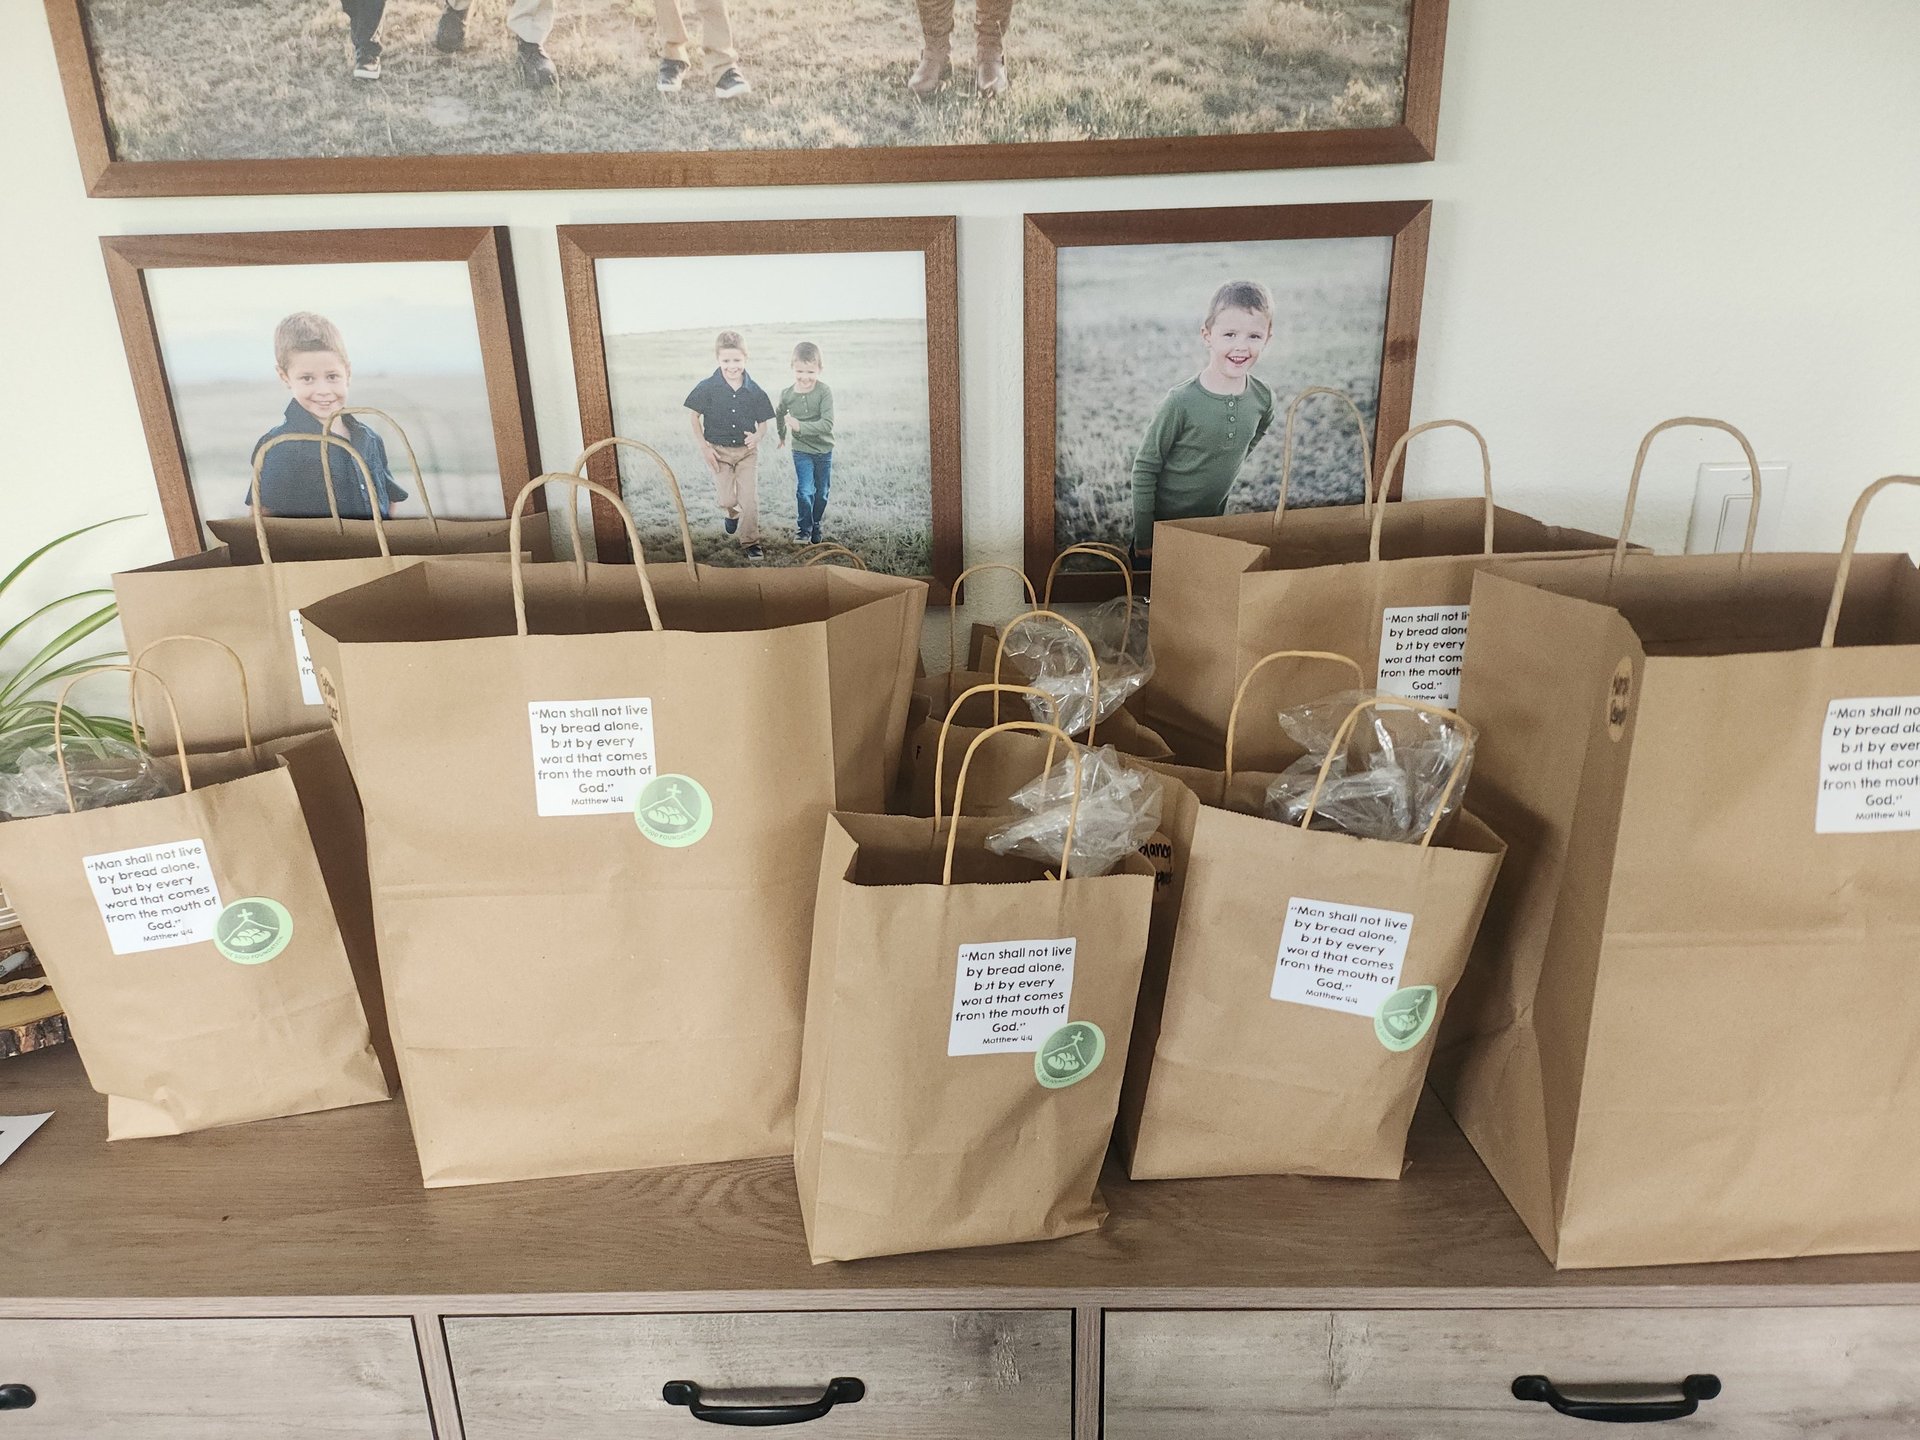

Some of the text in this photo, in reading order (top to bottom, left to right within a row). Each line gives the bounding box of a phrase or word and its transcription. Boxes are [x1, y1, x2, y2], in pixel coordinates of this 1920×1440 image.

[1386, 615, 1413, 623] “Man
[1417, 613, 1439, 622] shall
[1390, 628, 1403, 638] by
[1407, 627, 1438, 636] bread
[1416, 642, 1429, 651] by
[1433, 641, 1464, 649] every
[1415, 654, 1435, 663] that
[1409, 668, 1425, 676] the
[1412, 681, 1442, 690] God.”
[532, 706, 648, 718] “Man shall not live
[1830, 708, 1865, 719] “Man
[1870, 705, 1901, 717] shall
[540, 722, 643, 735] by bread alone,
[1833, 726, 1851, 738] by
[1855, 723, 1899, 735] bread
[576, 739, 592, 749] by
[597, 737, 634, 747] every
[1868, 742, 1885, 754] by
[577, 753, 601, 762] that
[607, 751, 647, 761] comes
[1867, 758, 1893, 770] that
[573, 769, 592, 778] the
[597, 766, 635, 777] mouth
[640, 765, 652, 774] of
[579, 784, 613, 793] God.”
[1861, 777, 1881, 788] the
[572, 797, 609, 805] Matthew
[1866, 794, 1902, 806] God.”
[1856, 812, 1895, 820] Matthew
[88, 847, 201, 871] “Man shall not live
[98, 861, 199, 884] by bread alone,
[112, 876, 193, 895] but by every
[106, 886, 210, 909] word that comes
[106, 897, 216, 923] from the mouth of
[1291, 906, 1407, 930] “Man shall not live
[147, 919, 181, 930] God.”
[1294, 919, 1397, 943] by bread alone,
[144, 934, 178, 942] Matthew
[1326, 937, 1342, 949] by
[1347, 942, 1385, 955] every
[962, 946, 1072, 961] “Man shall not live
[1324, 951, 1348, 961] that
[1352, 957, 1394, 970] comes
[967, 963, 1064, 978] by bread alone,
[1314, 963, 1334, 974] the
[1338, 969, 1377, 982] mouth
[1381, 975, 1395, 985] of
[998, 981, 1014, 990] by
[1019, 979, 1055, 988] every
[1317, 978, 1351, 991] God.”
[997, 994, 1020, 1003] that
[1025, 991, 1063, 1001] comes
[1306, 989, 1343, 1001] Matthew
[990, 1009, 1007, 1018] the
[1011, 1006, 1049, 1016] mouth
[1053, 1004, 1065, 1014] of
[993, 1022, 1025, 1032] God.”
